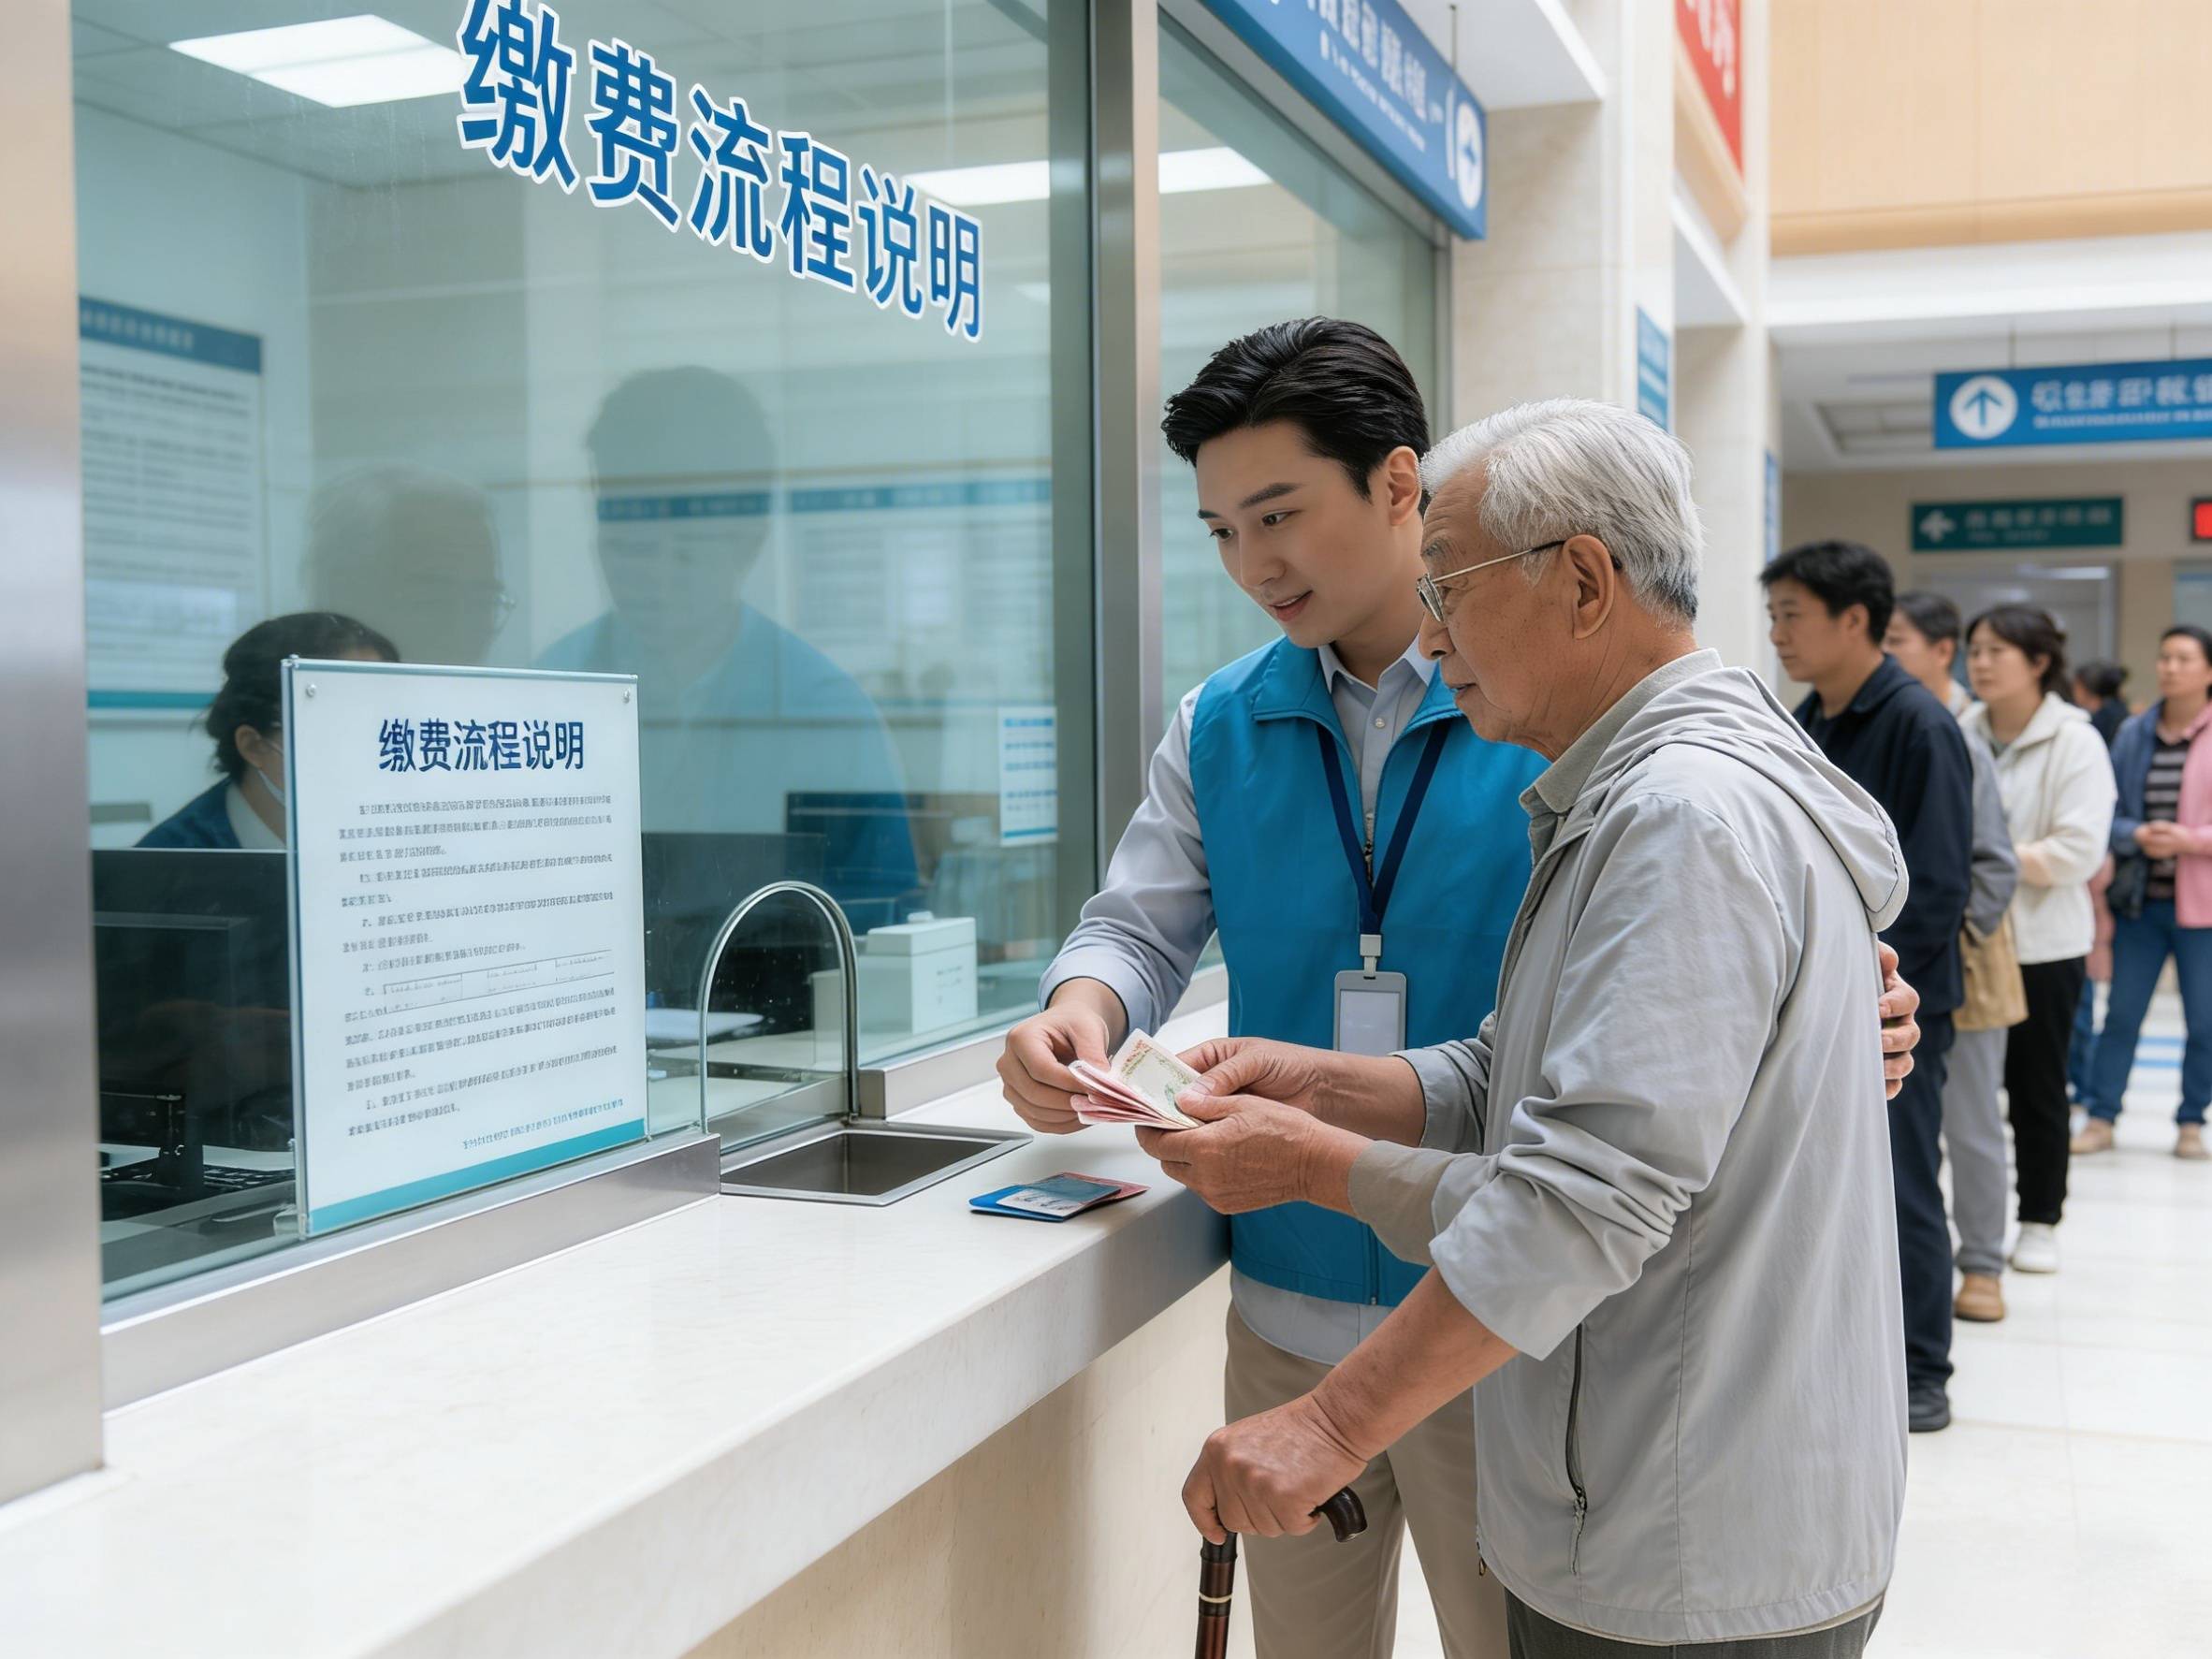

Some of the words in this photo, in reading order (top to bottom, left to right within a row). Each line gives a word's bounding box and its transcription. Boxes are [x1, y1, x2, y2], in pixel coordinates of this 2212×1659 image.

[458, 0, 982, 341] 缴费流程说明
[378, 718, 585, 772] 缴费流程说明
